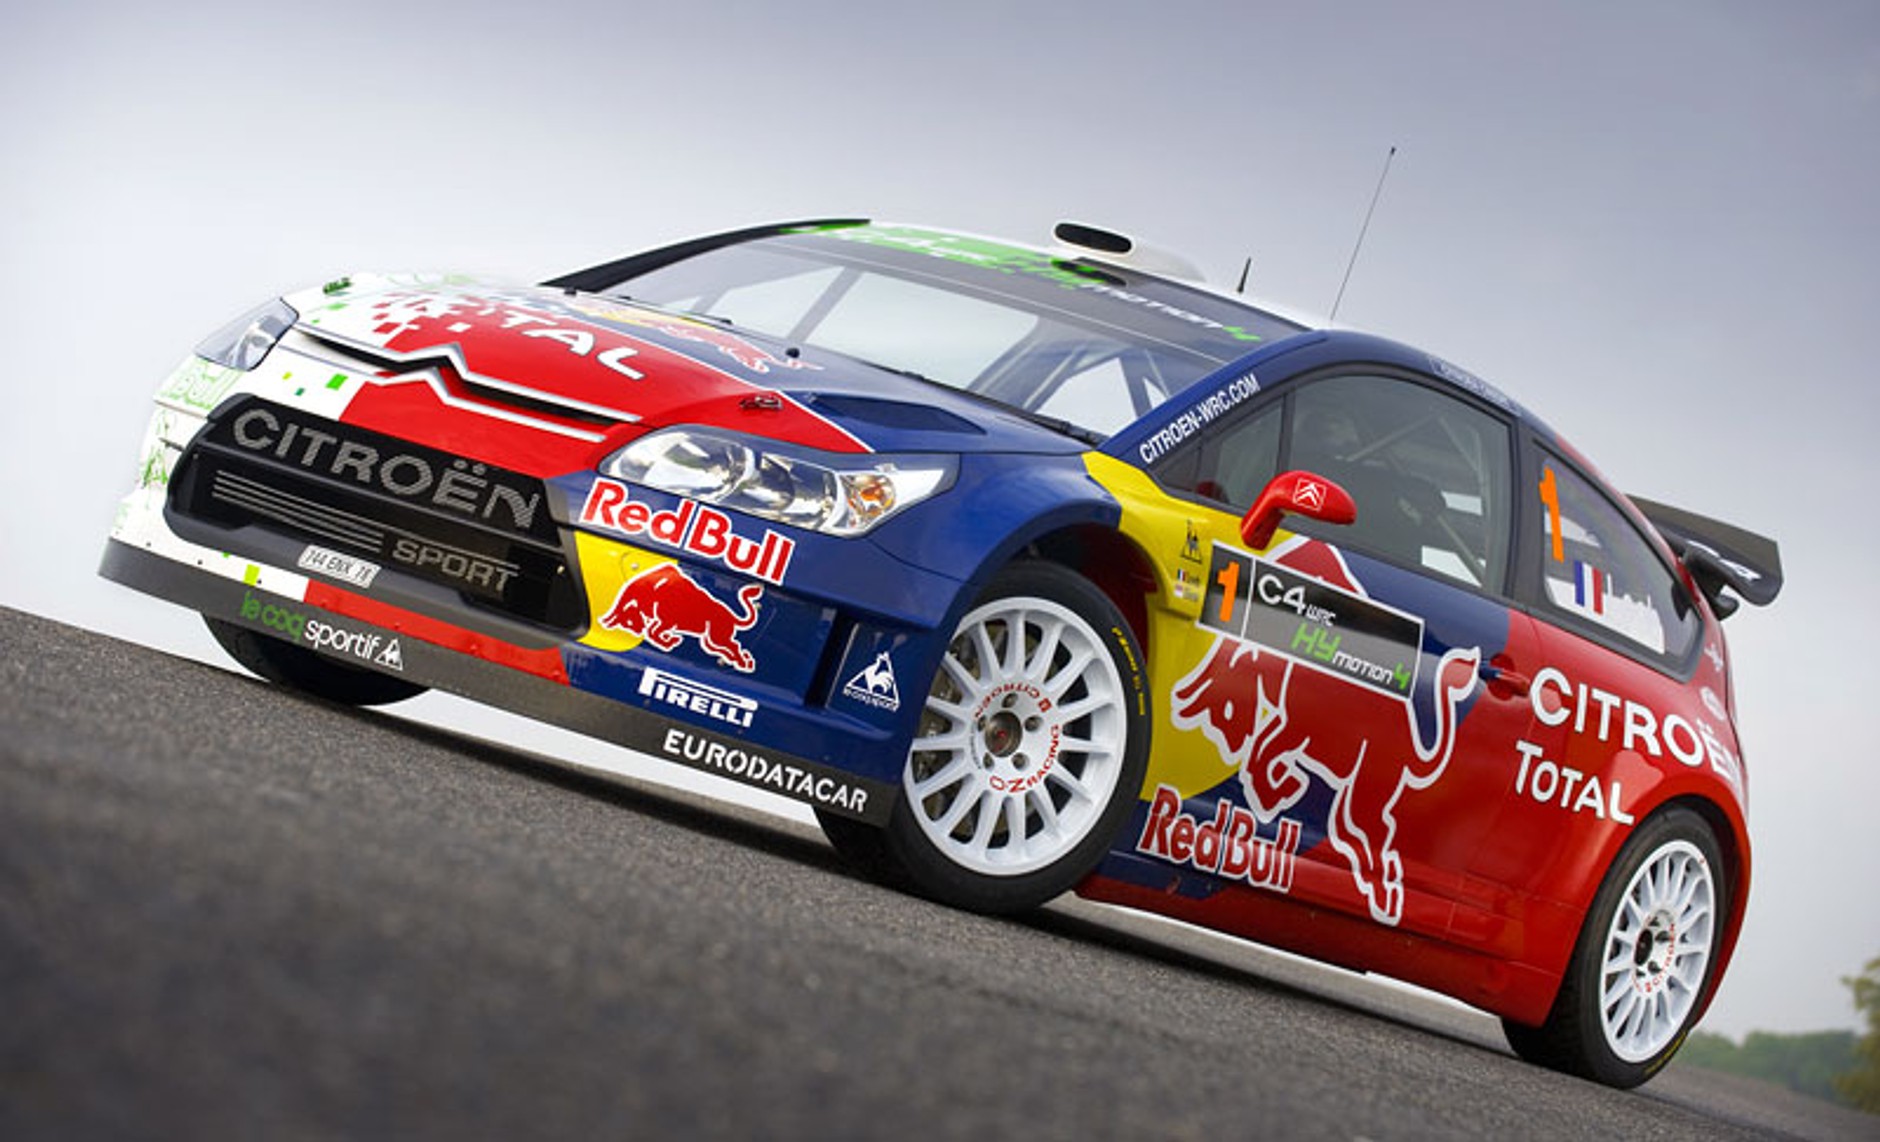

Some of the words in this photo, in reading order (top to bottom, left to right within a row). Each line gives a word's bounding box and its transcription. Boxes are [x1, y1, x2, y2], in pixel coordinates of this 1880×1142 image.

[1139, 373, 1261, 464] CITROEN-WRC.COM
[232, 408, 540, 529] CITROËN
[1538, 465, 1565, 564] 1
[392, 539, 519, 592] SPORT
[1216, 560, 1241, 622] 1
[1257, 573, 1306, 615] C4
[305, 619, 381, 661] sportif
[638, 666, 759, 729] PIRELLI
[663, 728, 869, 813] EURODATACAR
